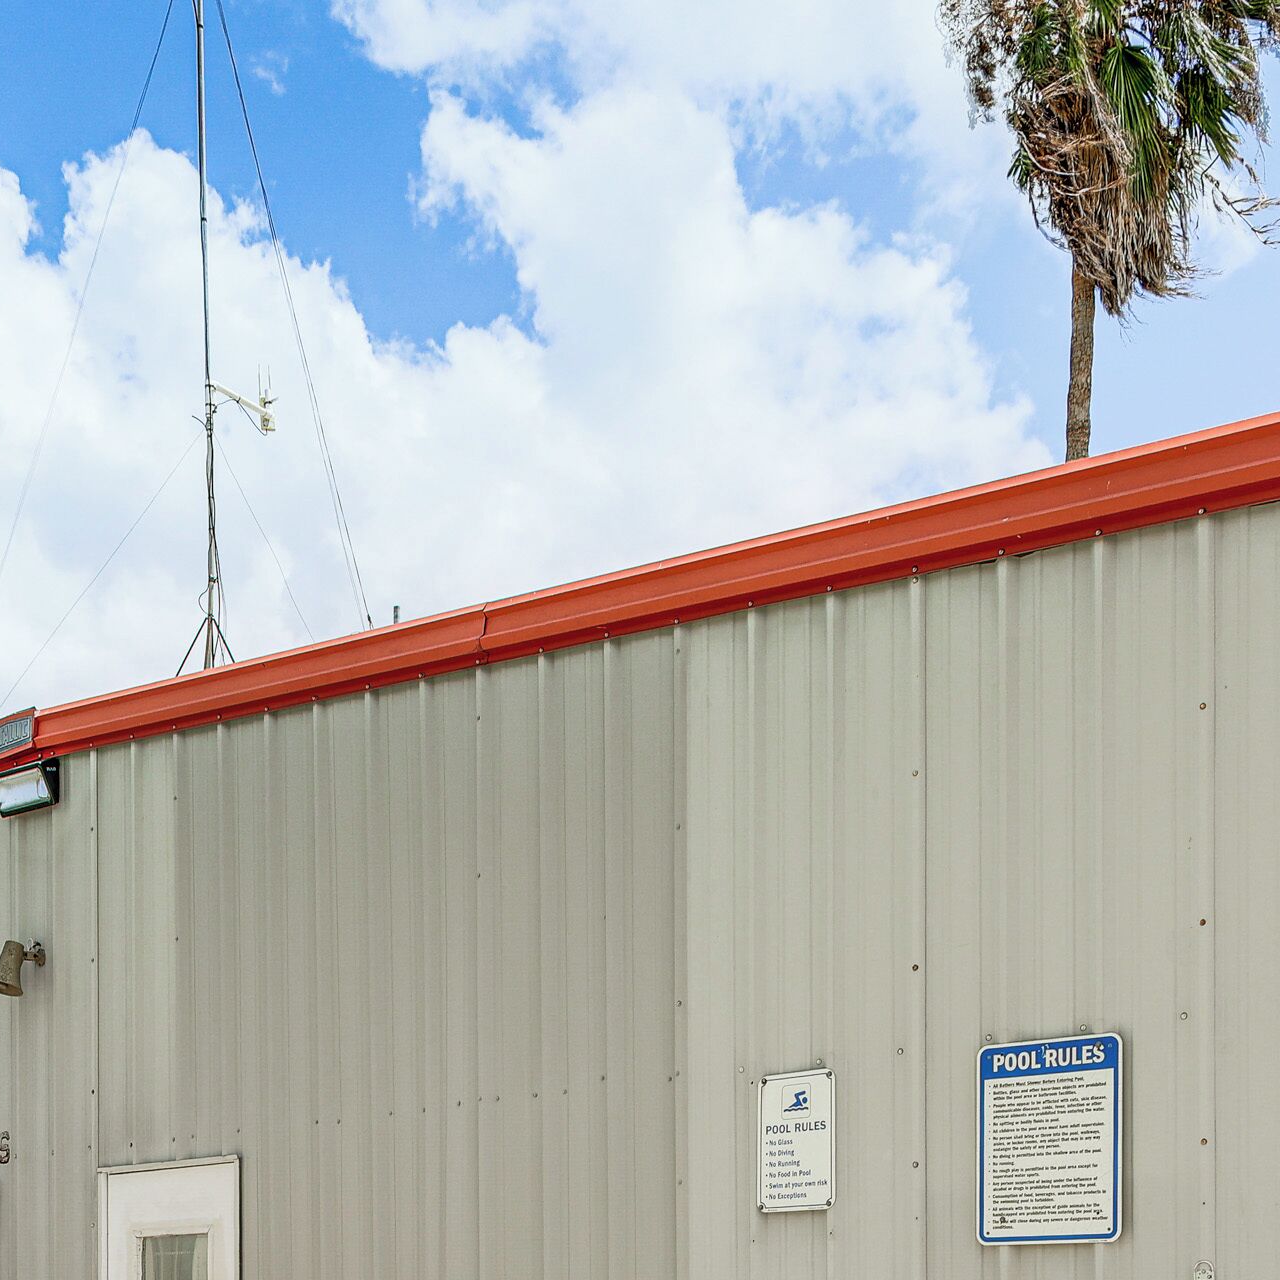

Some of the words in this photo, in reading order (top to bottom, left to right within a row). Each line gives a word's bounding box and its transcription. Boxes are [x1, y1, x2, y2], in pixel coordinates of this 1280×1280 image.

[993, 1052, 1041, 1072] POOL
[1045, 1045, 1105, 1067] RULES
[766, 1125, 791, 1135] POOL
[794, 1121, 826, 1132] RULES
[778, 1138, 793, 1146] Glass
[778, 1160, 800, 1168] Running
[792, 1182, 803, 1190] your
[778, 1192, 807, 1200] Exceptions
